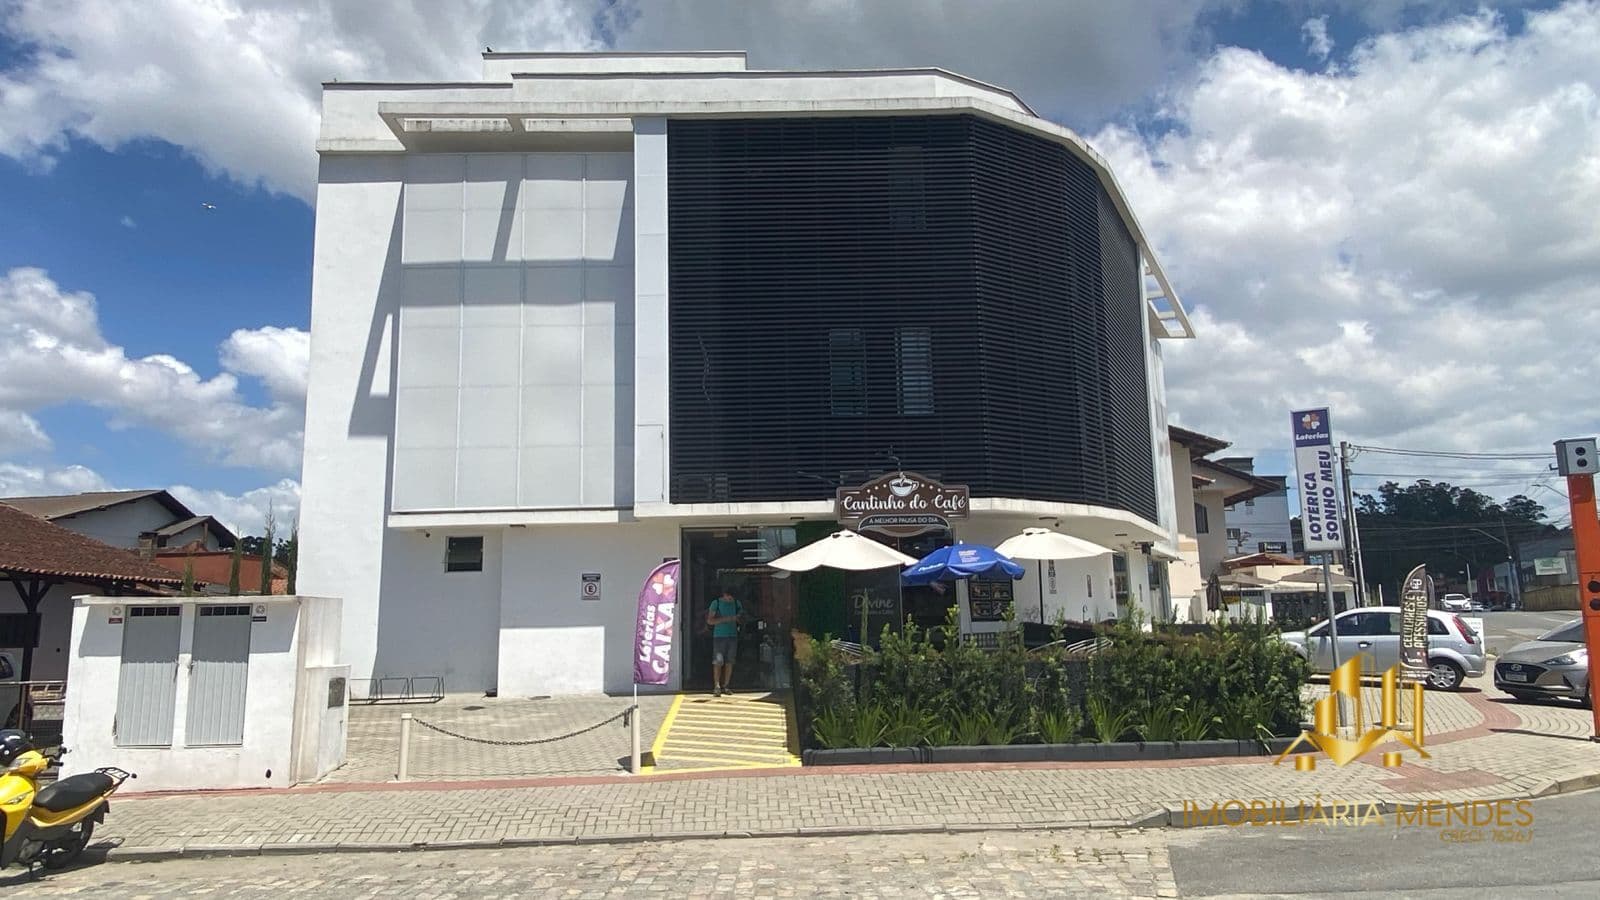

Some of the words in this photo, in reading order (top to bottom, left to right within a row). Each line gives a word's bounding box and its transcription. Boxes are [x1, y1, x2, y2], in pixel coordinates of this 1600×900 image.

[1295, 432, 1329, 441] Loterias
[1318, 450, 1333, 482] MEU
[841, 494, 905, 510] Cantinho
[909, 493, 927, 510] do
[933, 494, 967, 510] Café
[1303, 472, 1323, 541] LOTÉRICA
[1322, 486, 1340, 541] SONHO
[640, 604, 657, 662] Loterias
[652, 602, 676, 674] CAIXA
[1403, 601, 1416, 648] CELULARES
